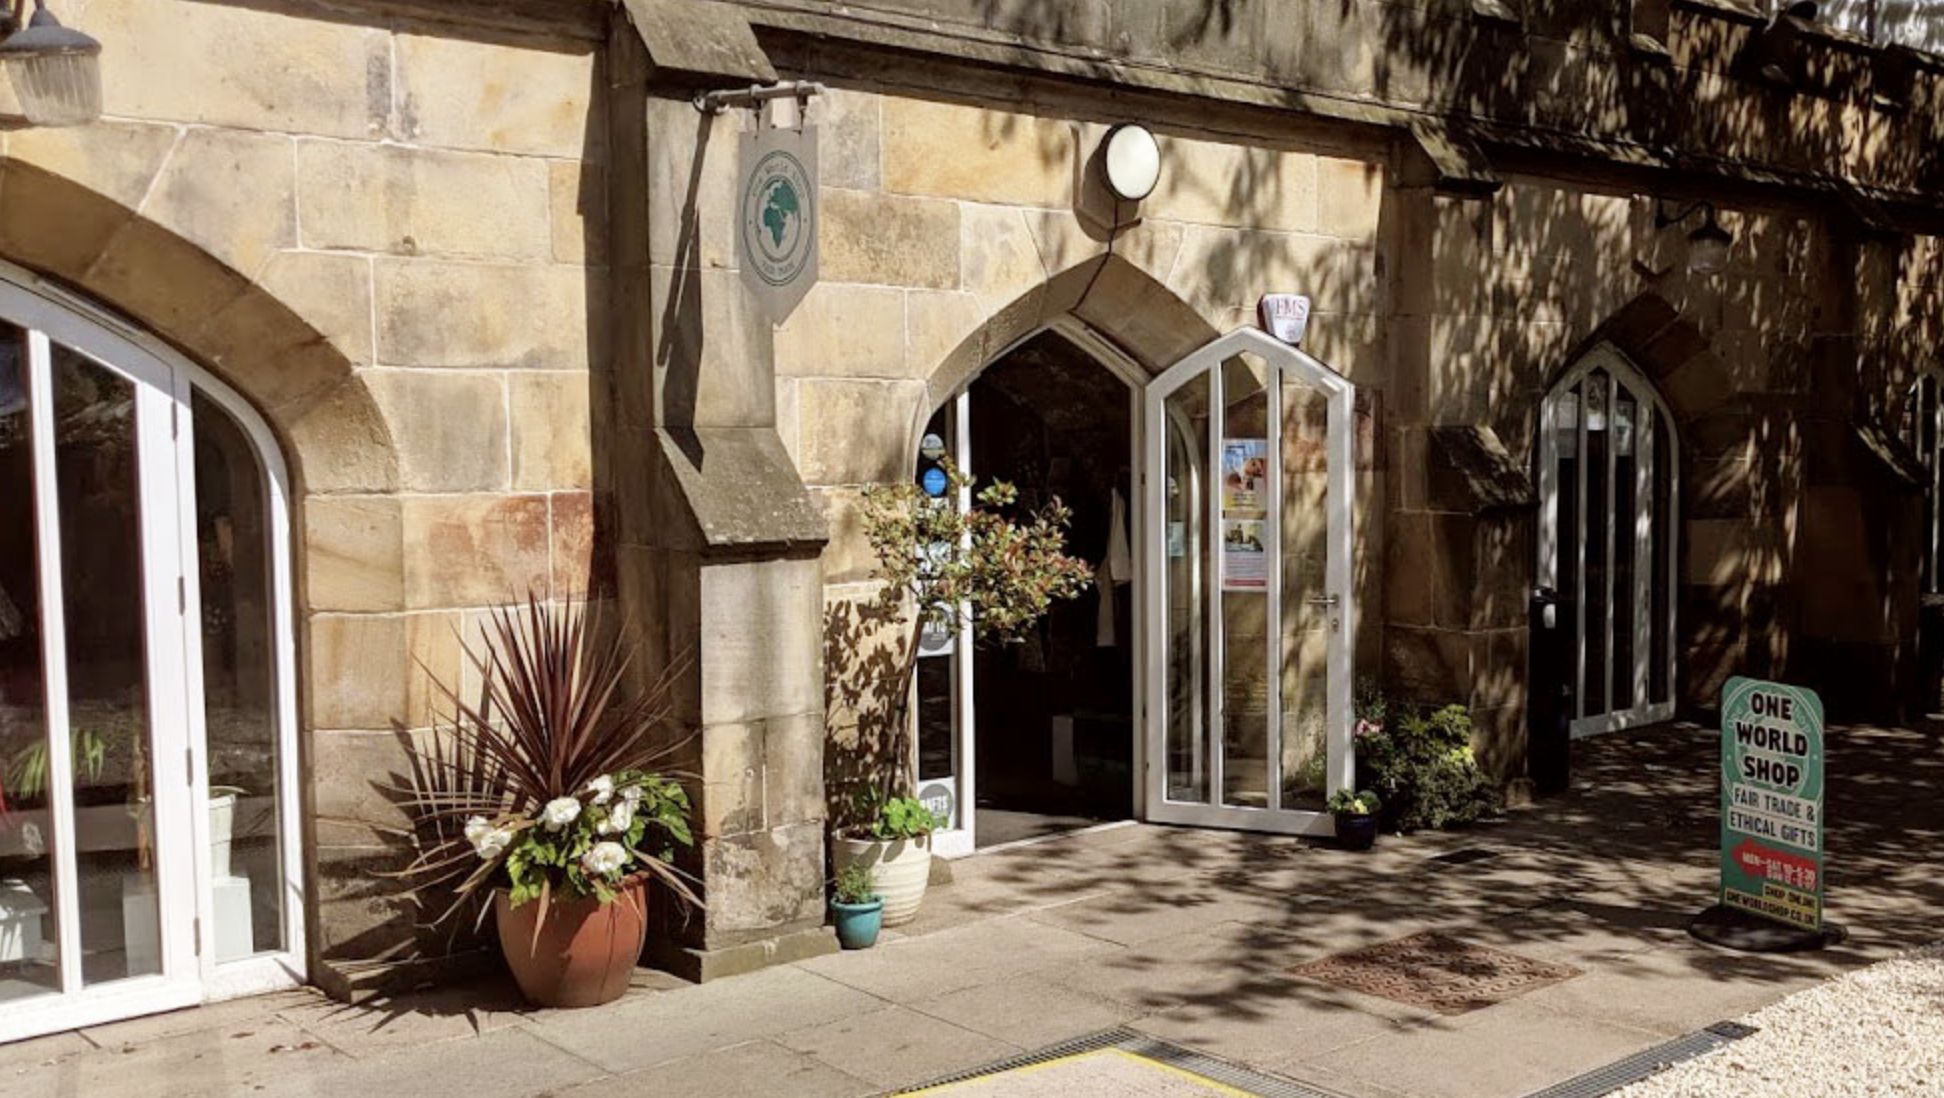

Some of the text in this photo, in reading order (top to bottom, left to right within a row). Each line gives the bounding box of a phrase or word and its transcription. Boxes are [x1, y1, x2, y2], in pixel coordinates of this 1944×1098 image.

[1751, 692, 1793, 721] ONE
[1736, 721, 1808, 757] WORLD
[1743, 755, 1800, 787] SHOP
[1734, 787, 1815, 822] FAIR TRADE &
[1730, 811, 1816, 848] ETHICAL GIFTS
